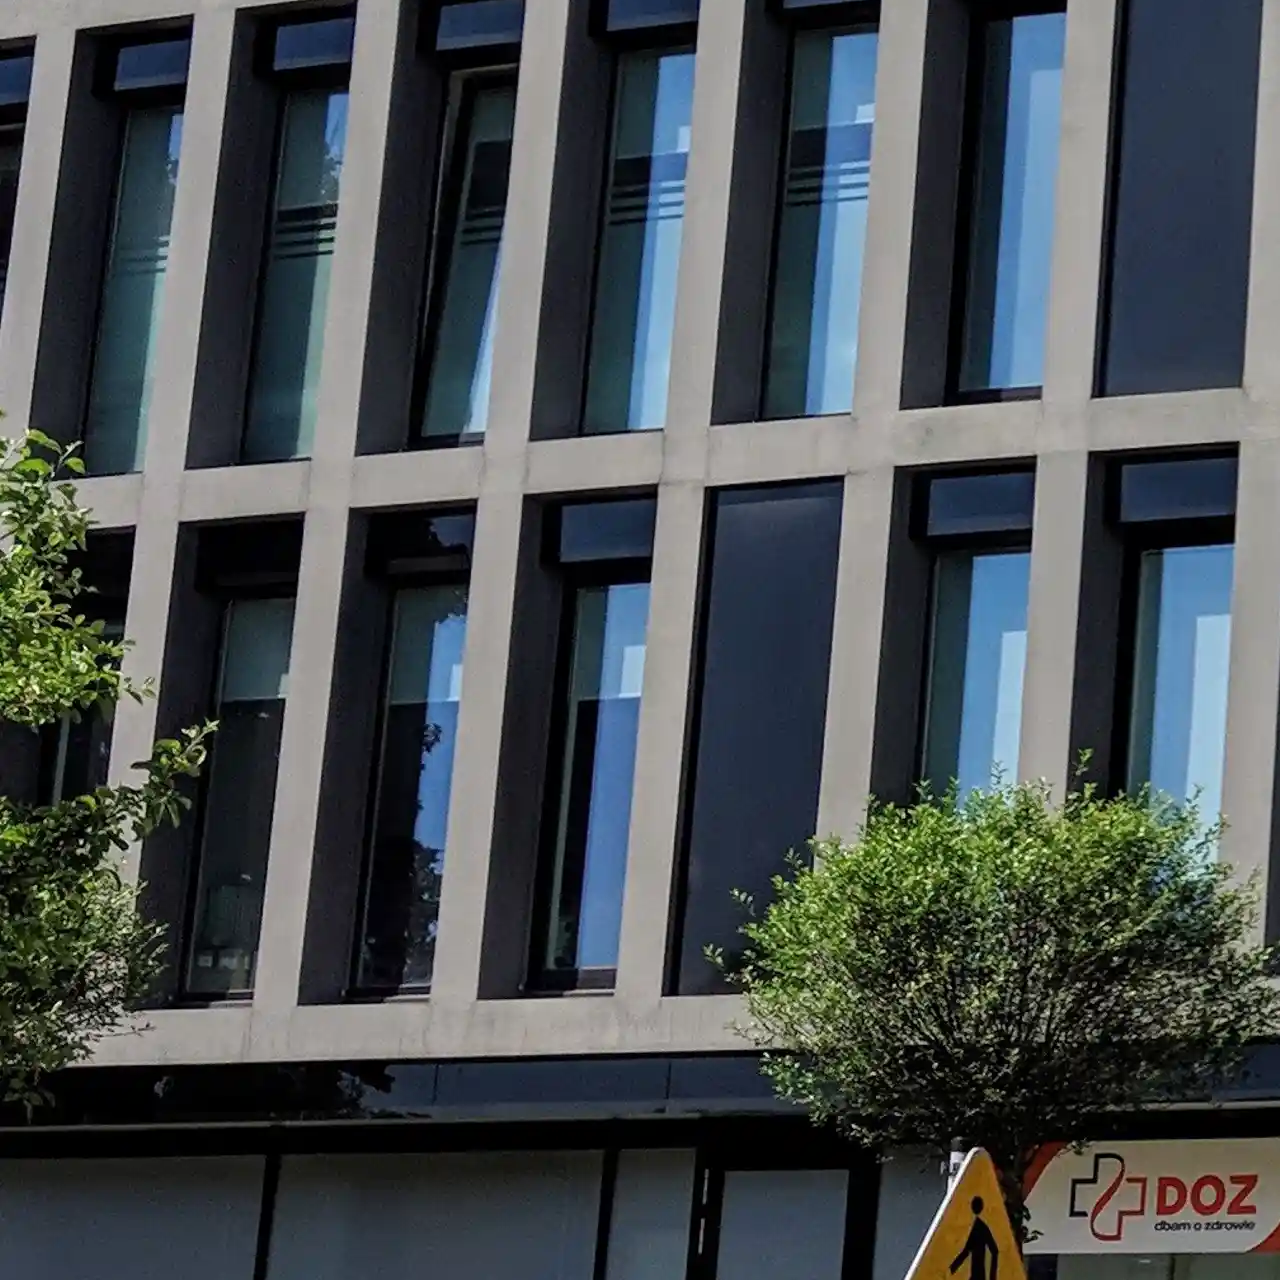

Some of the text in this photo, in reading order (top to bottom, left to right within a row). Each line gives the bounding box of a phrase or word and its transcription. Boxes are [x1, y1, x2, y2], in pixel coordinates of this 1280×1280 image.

[1156, 1174, 1258, 1216] DOZ
[1154, 1220, 1256, 1231] dbam o zdrowie
